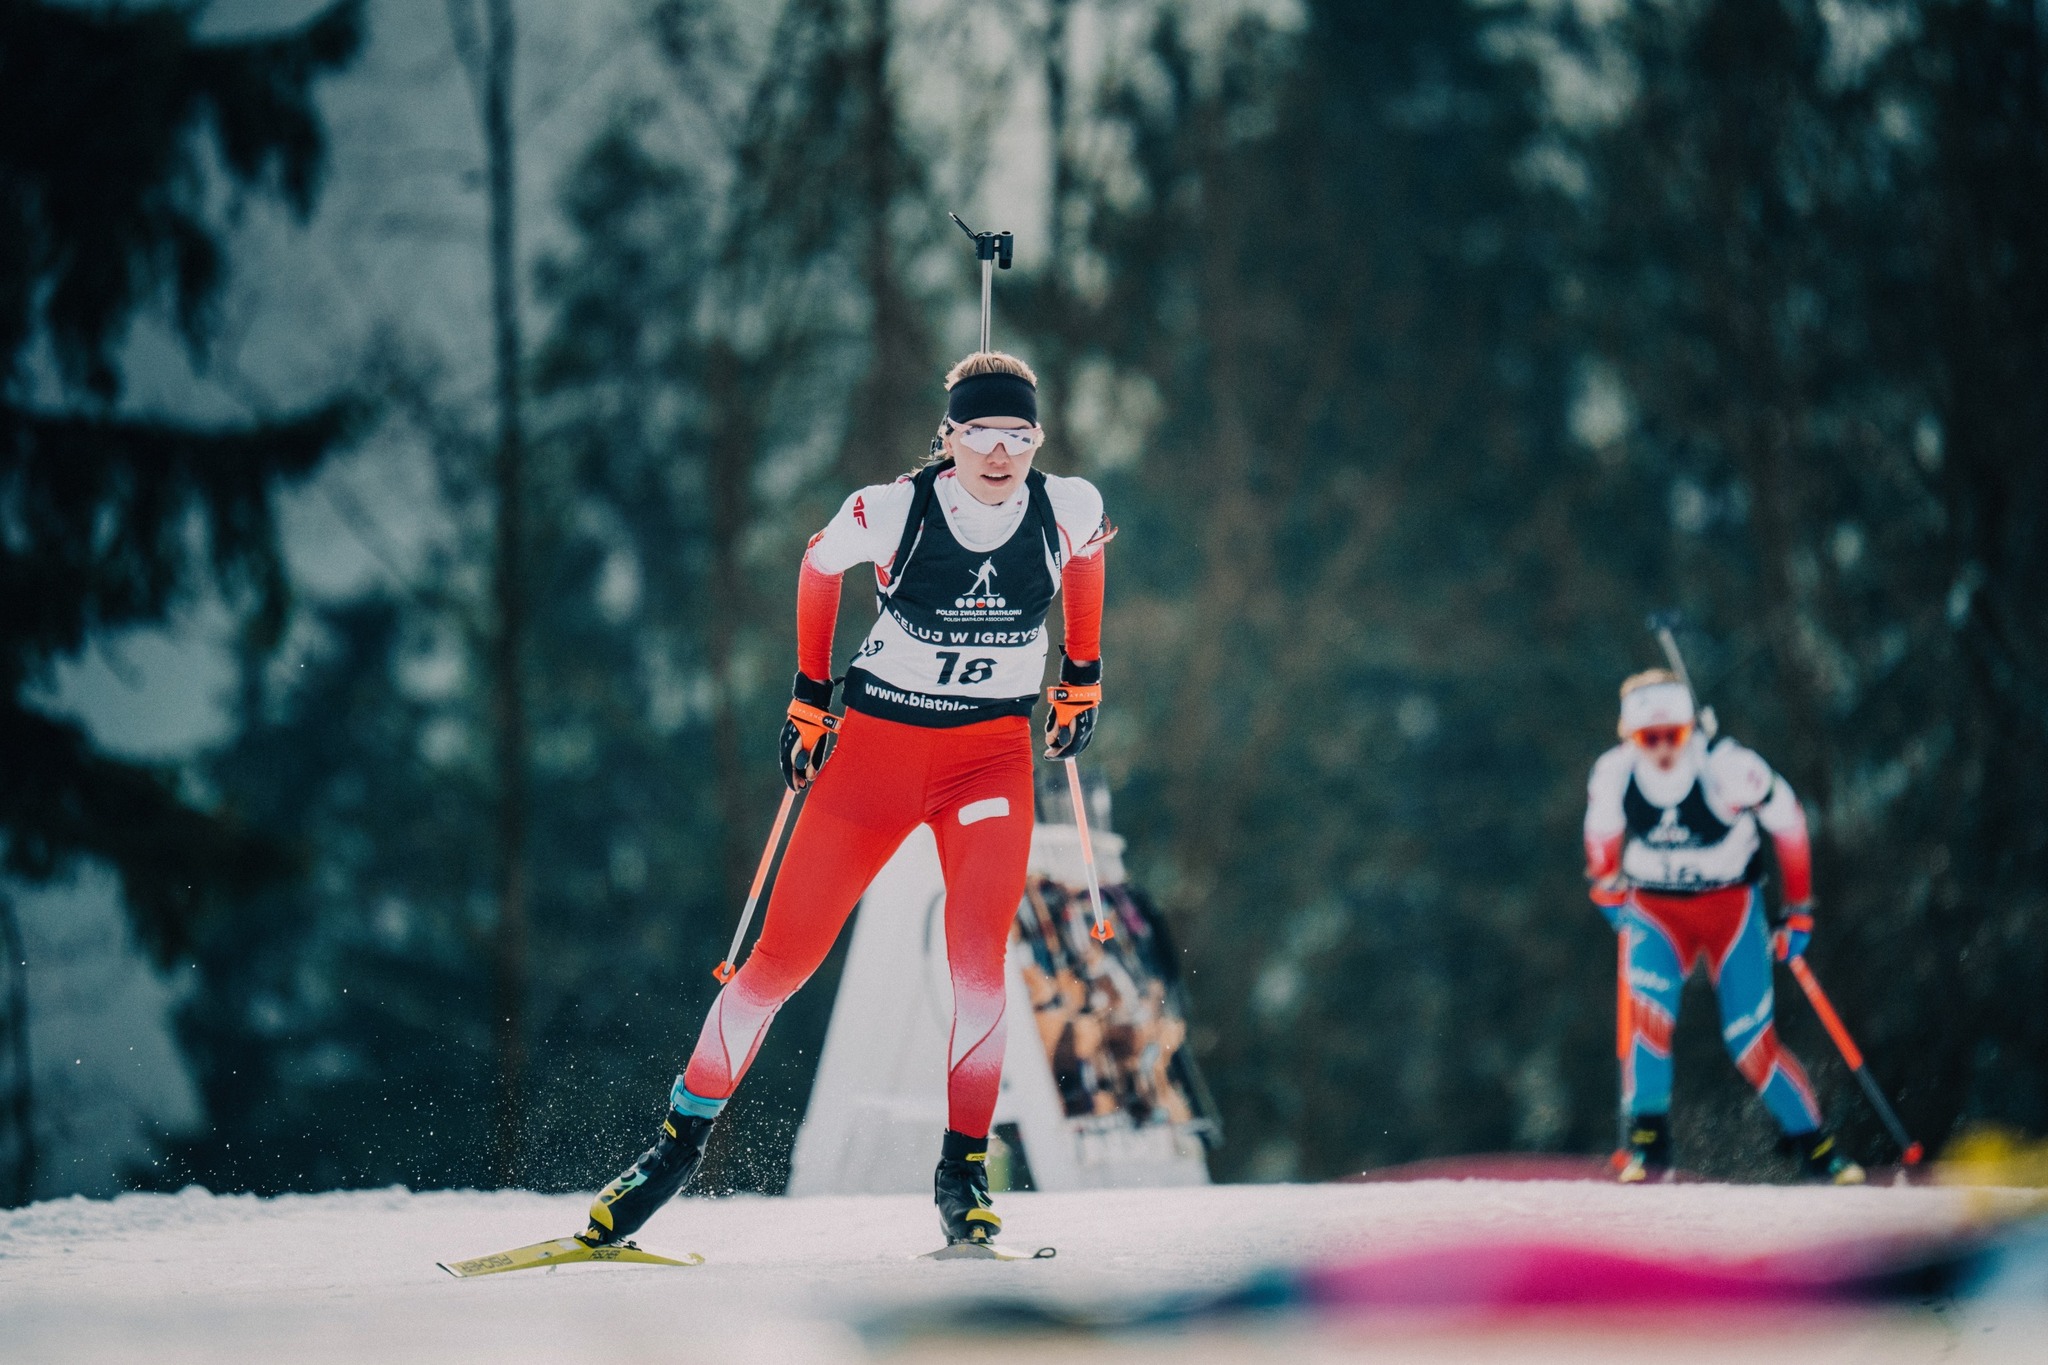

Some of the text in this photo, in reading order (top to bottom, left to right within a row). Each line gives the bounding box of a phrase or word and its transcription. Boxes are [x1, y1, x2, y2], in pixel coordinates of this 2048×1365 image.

[893, 609, 1042, 644] CELUJ W IGRZYS
[935, 608, 959, 616] POLSKI
[935, 651, 998, 685] 18
